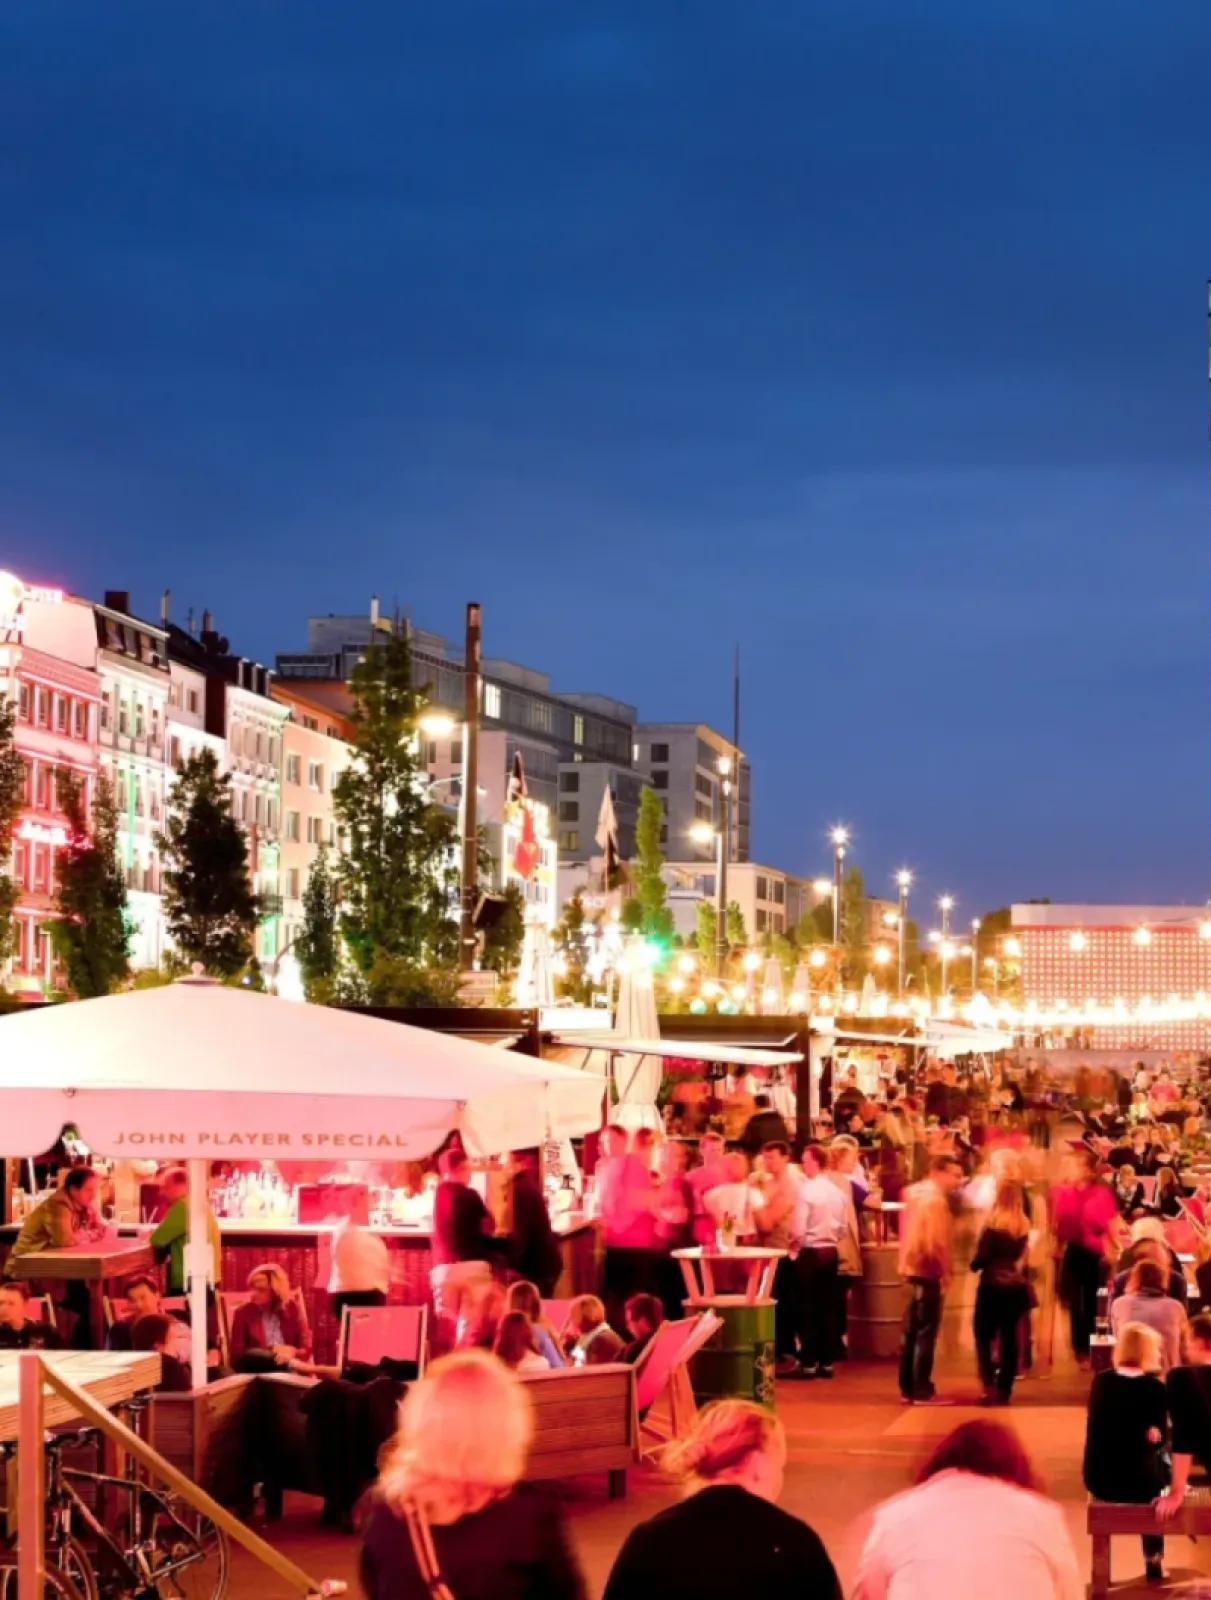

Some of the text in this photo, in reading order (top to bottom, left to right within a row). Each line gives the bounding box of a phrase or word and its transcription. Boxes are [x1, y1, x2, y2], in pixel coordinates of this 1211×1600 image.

[114, 1131, 408, 1147] JOHN PLAYER SPECIAL
